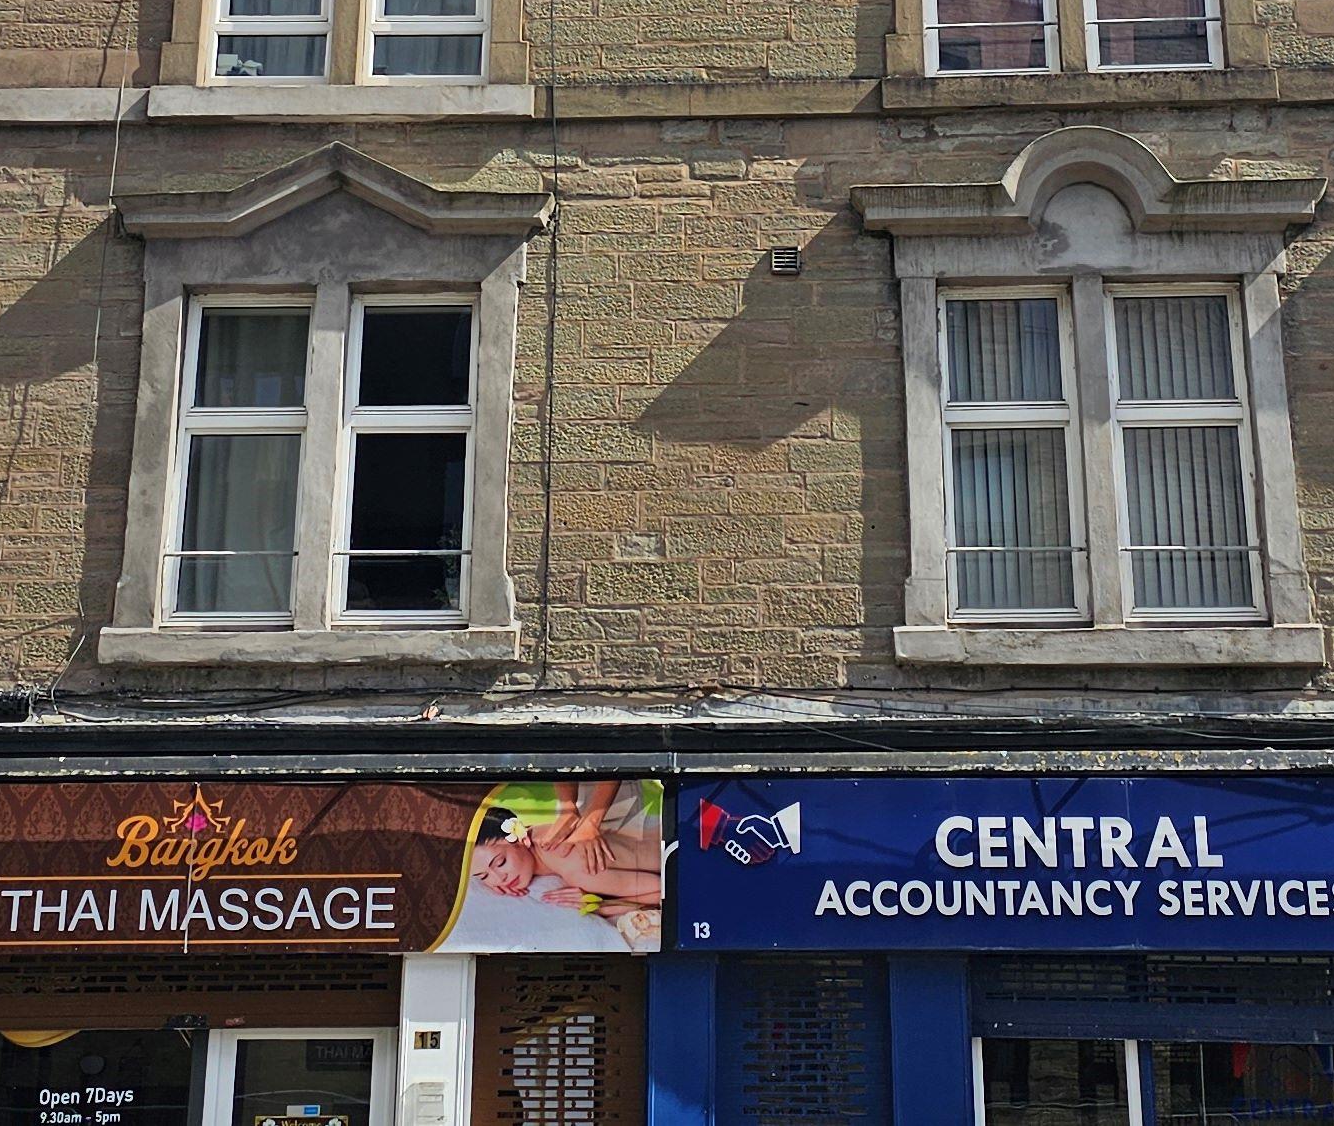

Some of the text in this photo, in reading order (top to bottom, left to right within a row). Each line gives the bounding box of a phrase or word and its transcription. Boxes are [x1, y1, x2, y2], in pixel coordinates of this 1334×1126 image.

[107, 815, 298, 882] Bangkok
[935, 815, 1224, 869] CENTRAL
[0, 886, 397, 932] THAI MASSAGE
[815, 879, 1141, 917] ACCOUNTANCY
[692, 922, 711, 939] 13
[418, 1031, 440, 1049] 15
[39, 1087, 134, 1109] Open 7Days
[40, 1112, 82, 1124] 9.30am
[95, 1111, 121, 1125] 5pm
